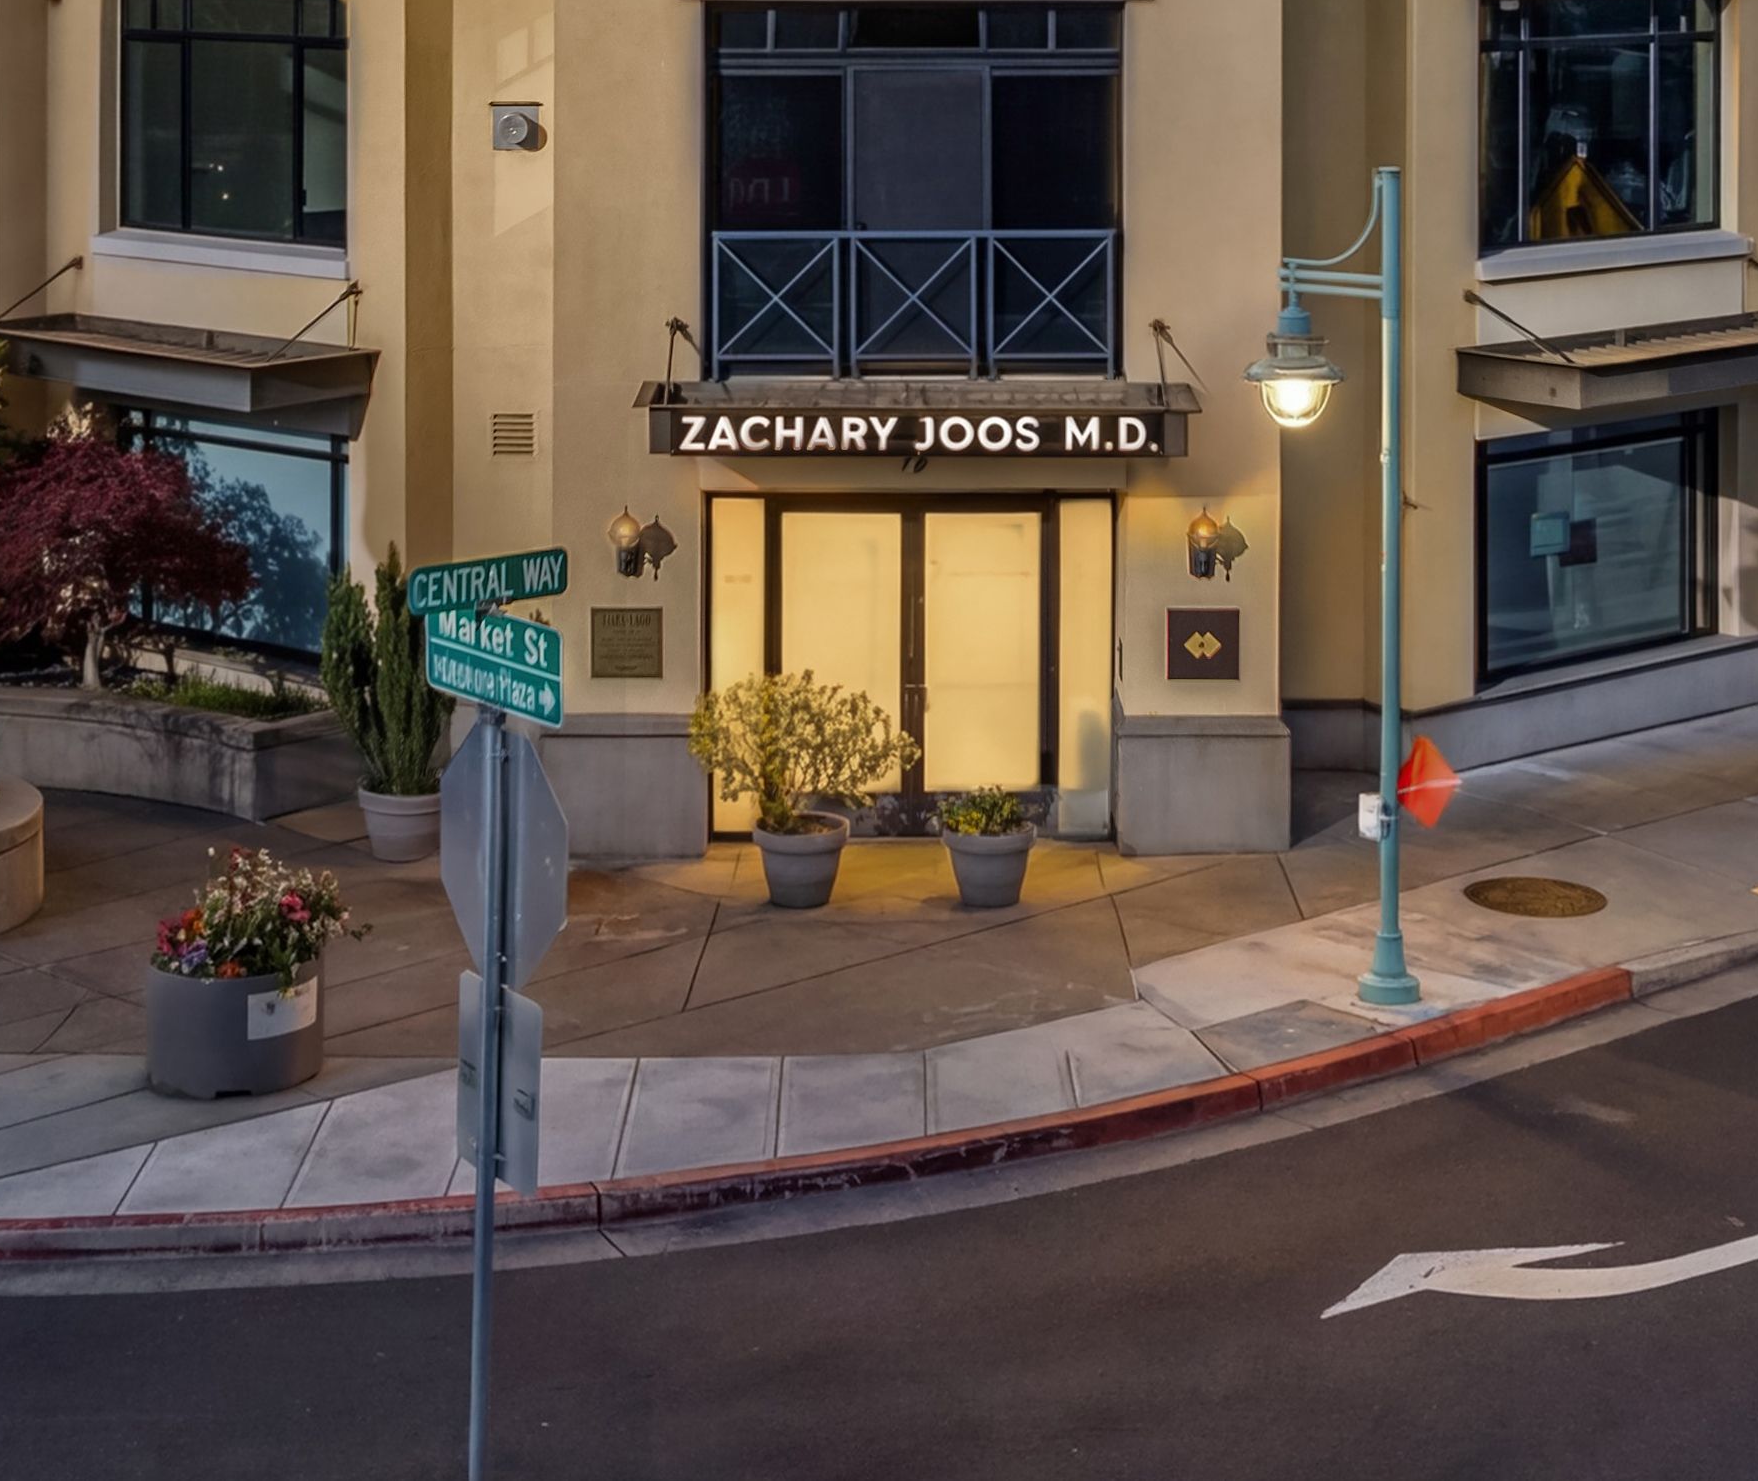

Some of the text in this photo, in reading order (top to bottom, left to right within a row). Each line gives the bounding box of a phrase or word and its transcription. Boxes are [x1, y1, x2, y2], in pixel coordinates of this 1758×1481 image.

[679, 416, 1160, 453] ZACHARY JOOS M.D.
[413, 553, 565, 609] CENTRAL WAY
[438, 609, 514, 658] Market
[524, 628, 548, 668] St
[499, 666, 536, 712] Plaza
